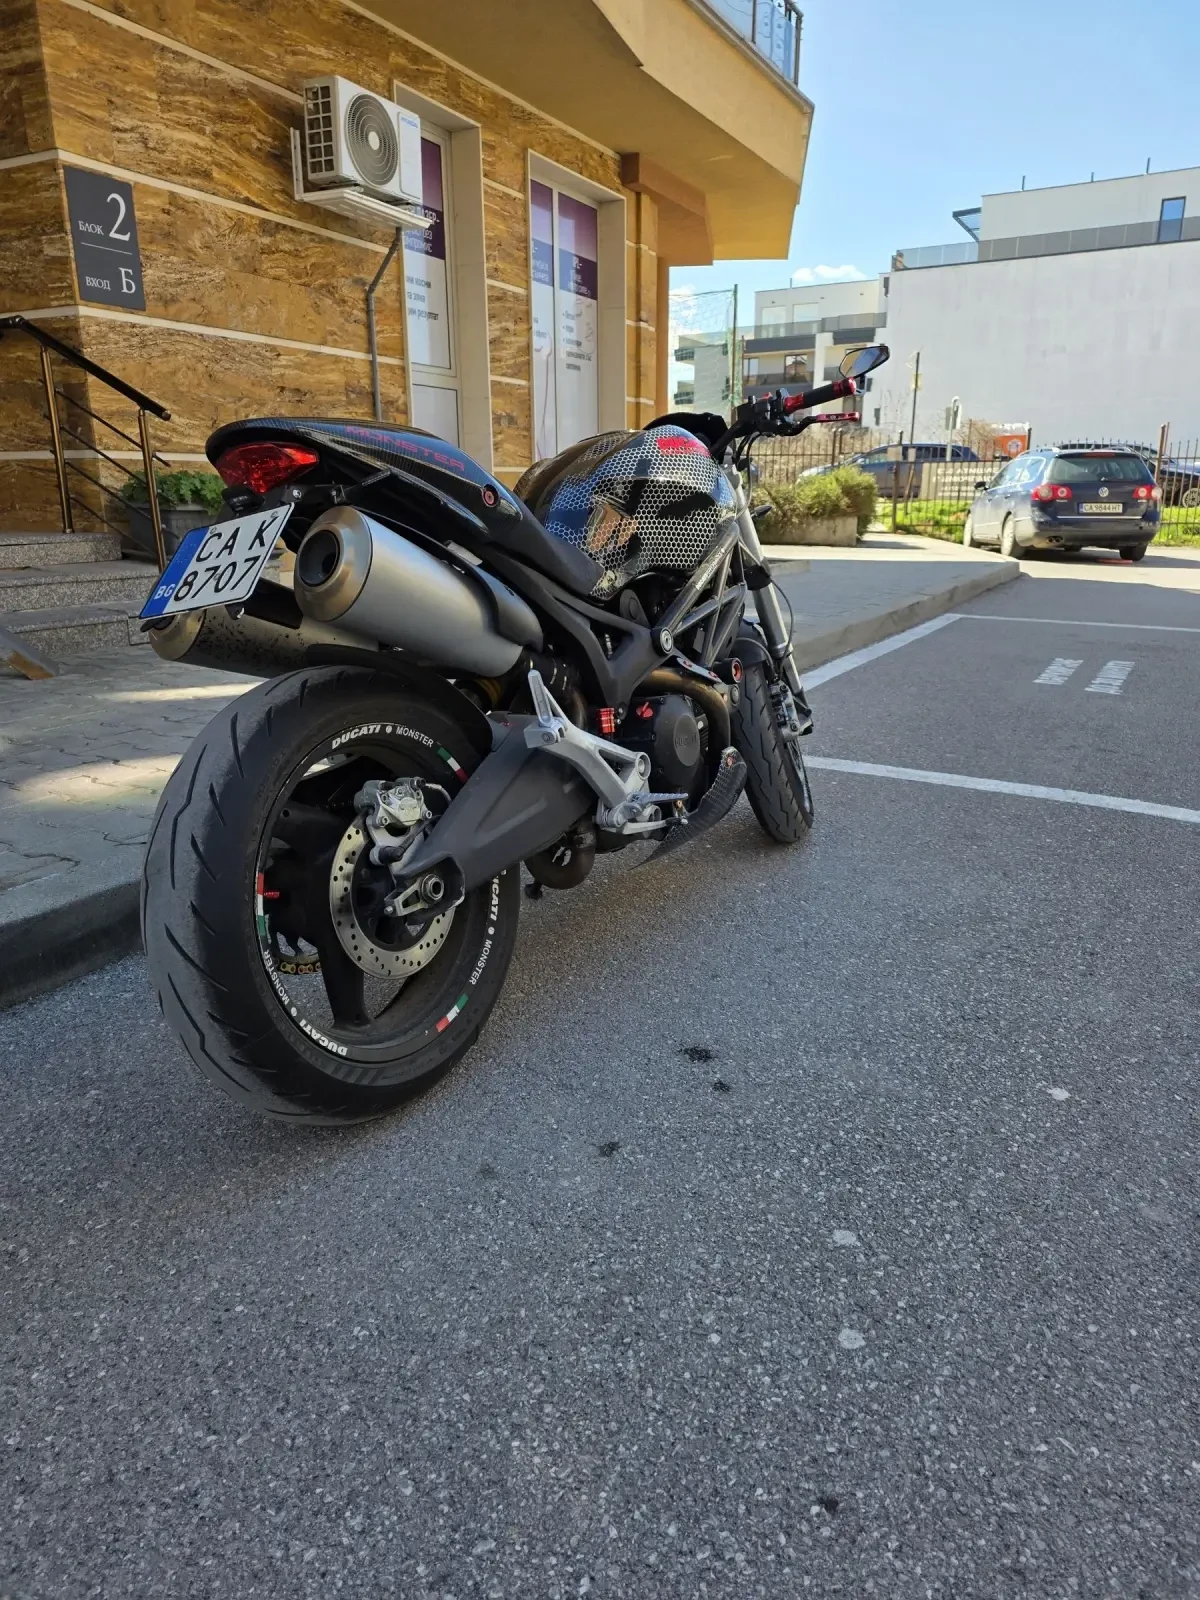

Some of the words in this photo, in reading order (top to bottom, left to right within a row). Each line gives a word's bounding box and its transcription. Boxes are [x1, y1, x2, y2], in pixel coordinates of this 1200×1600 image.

[78, 220, 104, 235] БЛОК
[106, 192, 131, 242] 2
[85, 276, 111, 291] ВХОД
[118, 267, 136, 294] Б
[196, 526, 241, 563] CA
[248, 515, 280, 551] K
[154, 583, 176, 600] BG
[173, 555, 262, 602] 8707
[332, 724, 381, 750] DUCATI
[396, 725, 434, 748] MONSTER
[263, 949, 290, 1005] MONSTER
[468, 939, 493, 985] MONSTER
[299, 1019, 348, 1056] DUCATI
